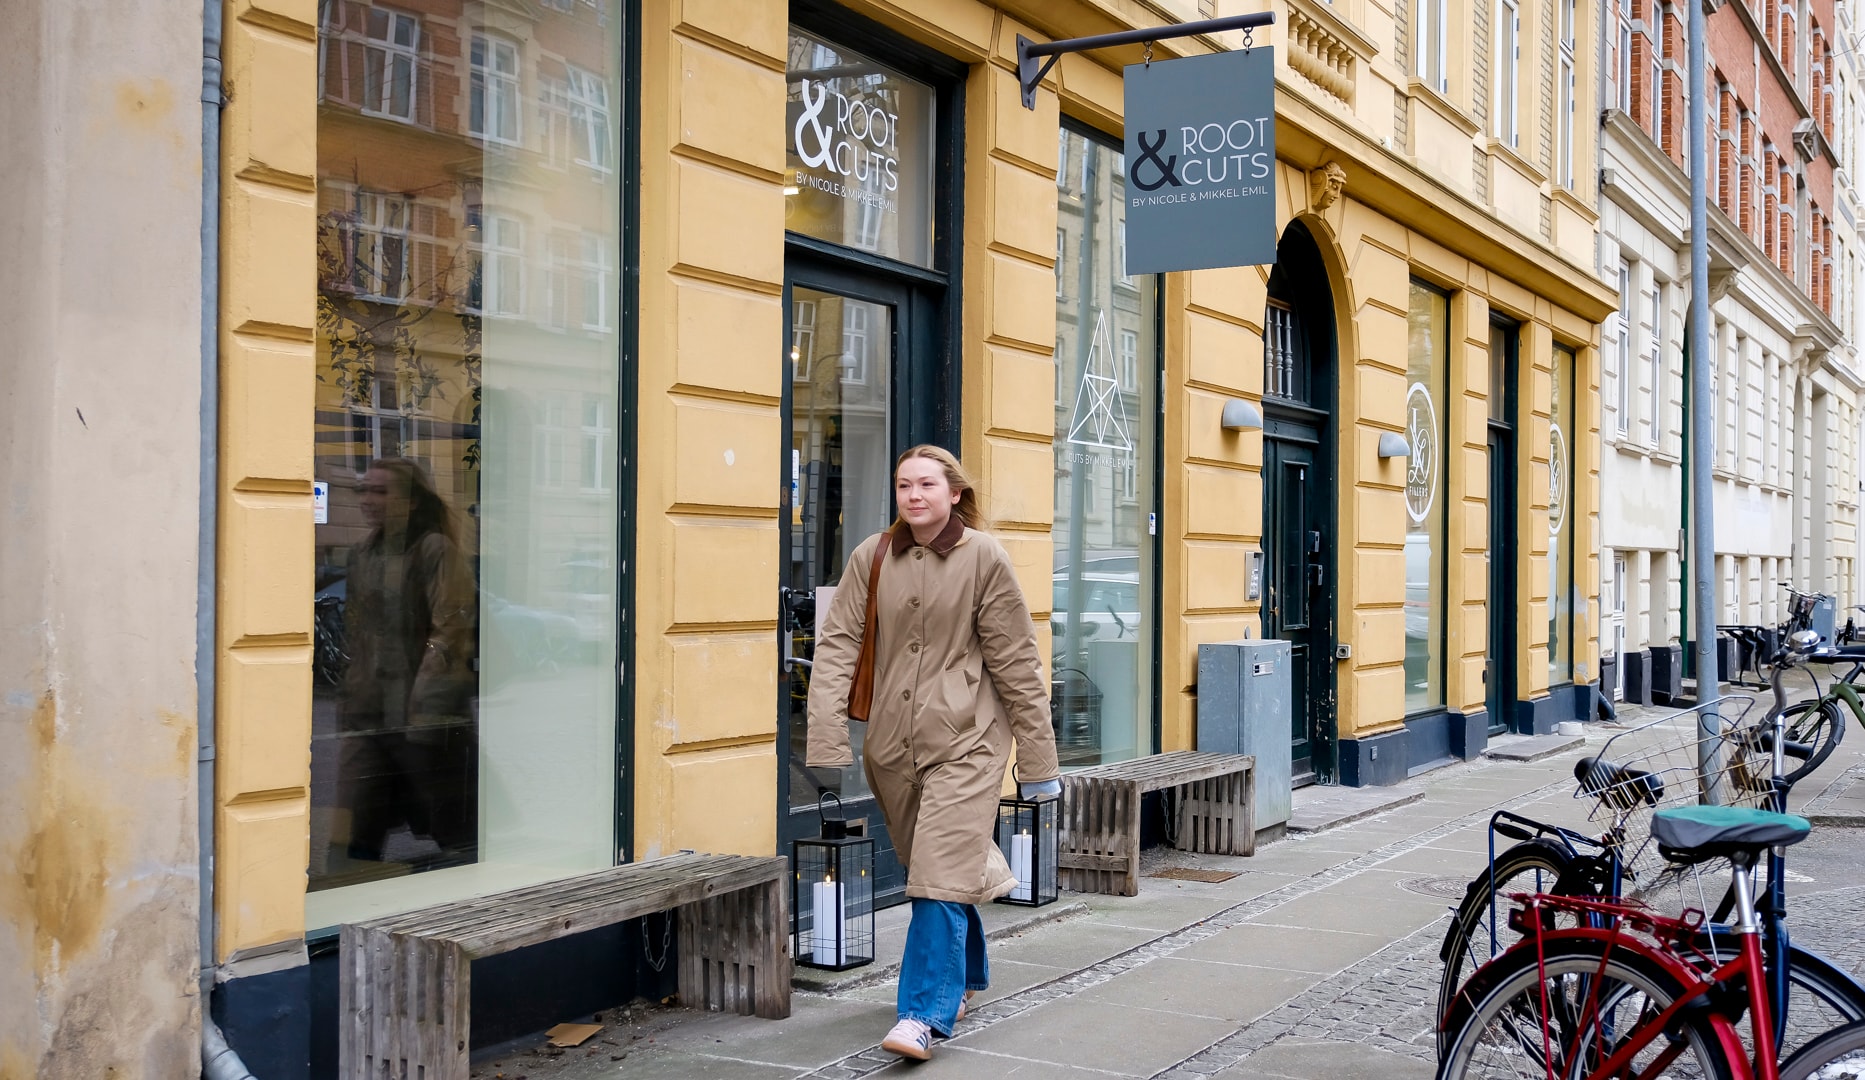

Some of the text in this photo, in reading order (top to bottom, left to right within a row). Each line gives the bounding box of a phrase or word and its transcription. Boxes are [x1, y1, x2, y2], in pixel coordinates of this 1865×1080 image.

[795, 78, 898, 192] & CUTS
[836, 93, 898, 151] ROOT
[1180, 117, 1269, 156] ROOT
[1130, 128, 1270, 192] & CUTS
[796, 171, 897, 214] BY NICOLE & MIKKEL EMIL
[1132, 186, 1269, 208] BY NICOLE & MIKKEL EMIL
[1069, 453, 1084, 464] CUTS
[1086, 455, 1093, 465] BY
